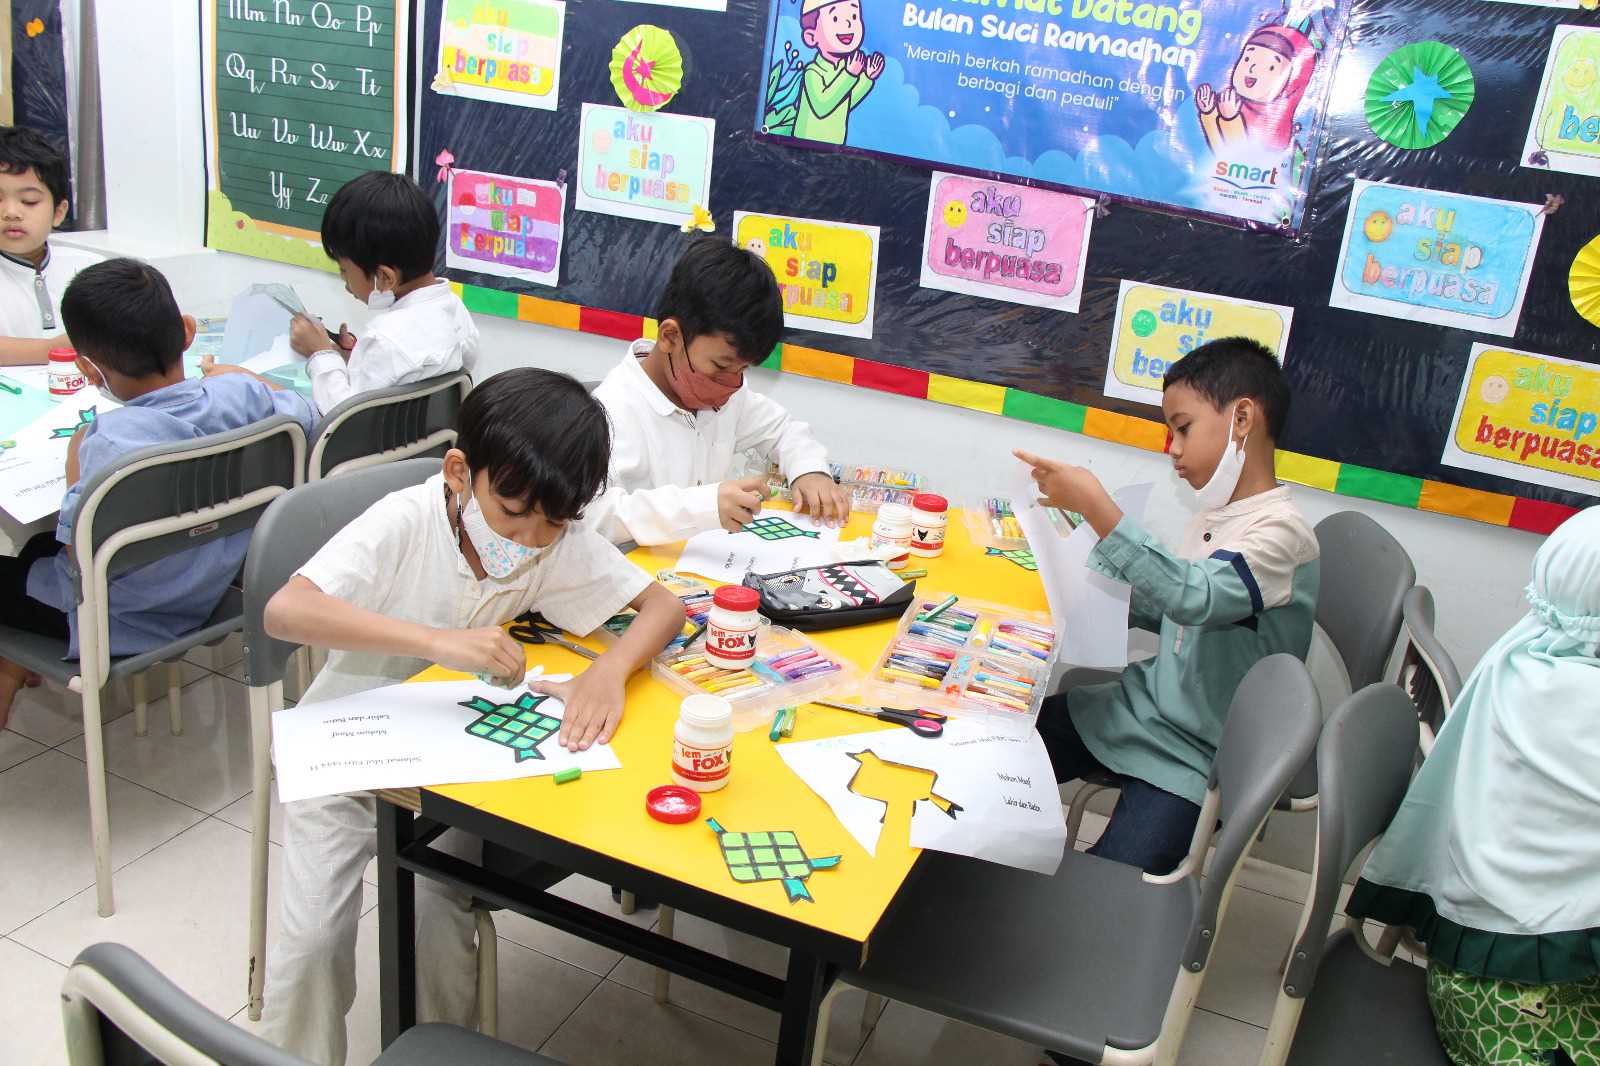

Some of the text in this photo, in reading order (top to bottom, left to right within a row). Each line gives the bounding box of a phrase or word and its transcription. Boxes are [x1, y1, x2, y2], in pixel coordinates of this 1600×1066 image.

[273, 0, 304, 26] Nn
[311, 2, 346, 30] Oo
[356, 4, 382, 48] Pp
[902, 3, 974, 35] Bulan
[981, 14, 1039, 44] Suci
[1043, 22, 1197, 69] Ramadhan
[1071, 0, 1202, 46] Datang
[226, 52, 382, 96] Qq Rr Ss Tt
[903, 42, 960, 65] "Meraih
[965, 52, 1020, 74] berkah
[1024, 64, 1114, 89] ramadhan
[957, 72, 1120, 112] berbagi dan peduli"
[229, 111, 387, 159] Uu Vv Ww Xx
[613, 116, 653, 144] aku
[628, 144, 675, 178] siap
[1215, 161, 1278, 185] smart
[269, 170, 293, 209] Yy
[595, 163, 690, 203] berpuasa
[970, 185, 1022, 218] aku
[1395, 201, 1456, 232] aku
[769, 223, 812, 251] aku
[986, 219, 1045, 257] siap
[1414, 232, 1484, 273] siap
[785, 254, 837, 288] siap
[944, 237, 1062, 284] berpuasa
[1361, 253, 1499, 304] berpuasa
[1159, 298, 1212, 328] aku
[66, 376, 84, 389] FOX
[1514, 363, 1574, 397] aku
[1529, 399, 1598, 440] siap
[718, 636, 745, 648] FOX
[693, 753, 724, 770] FOX
